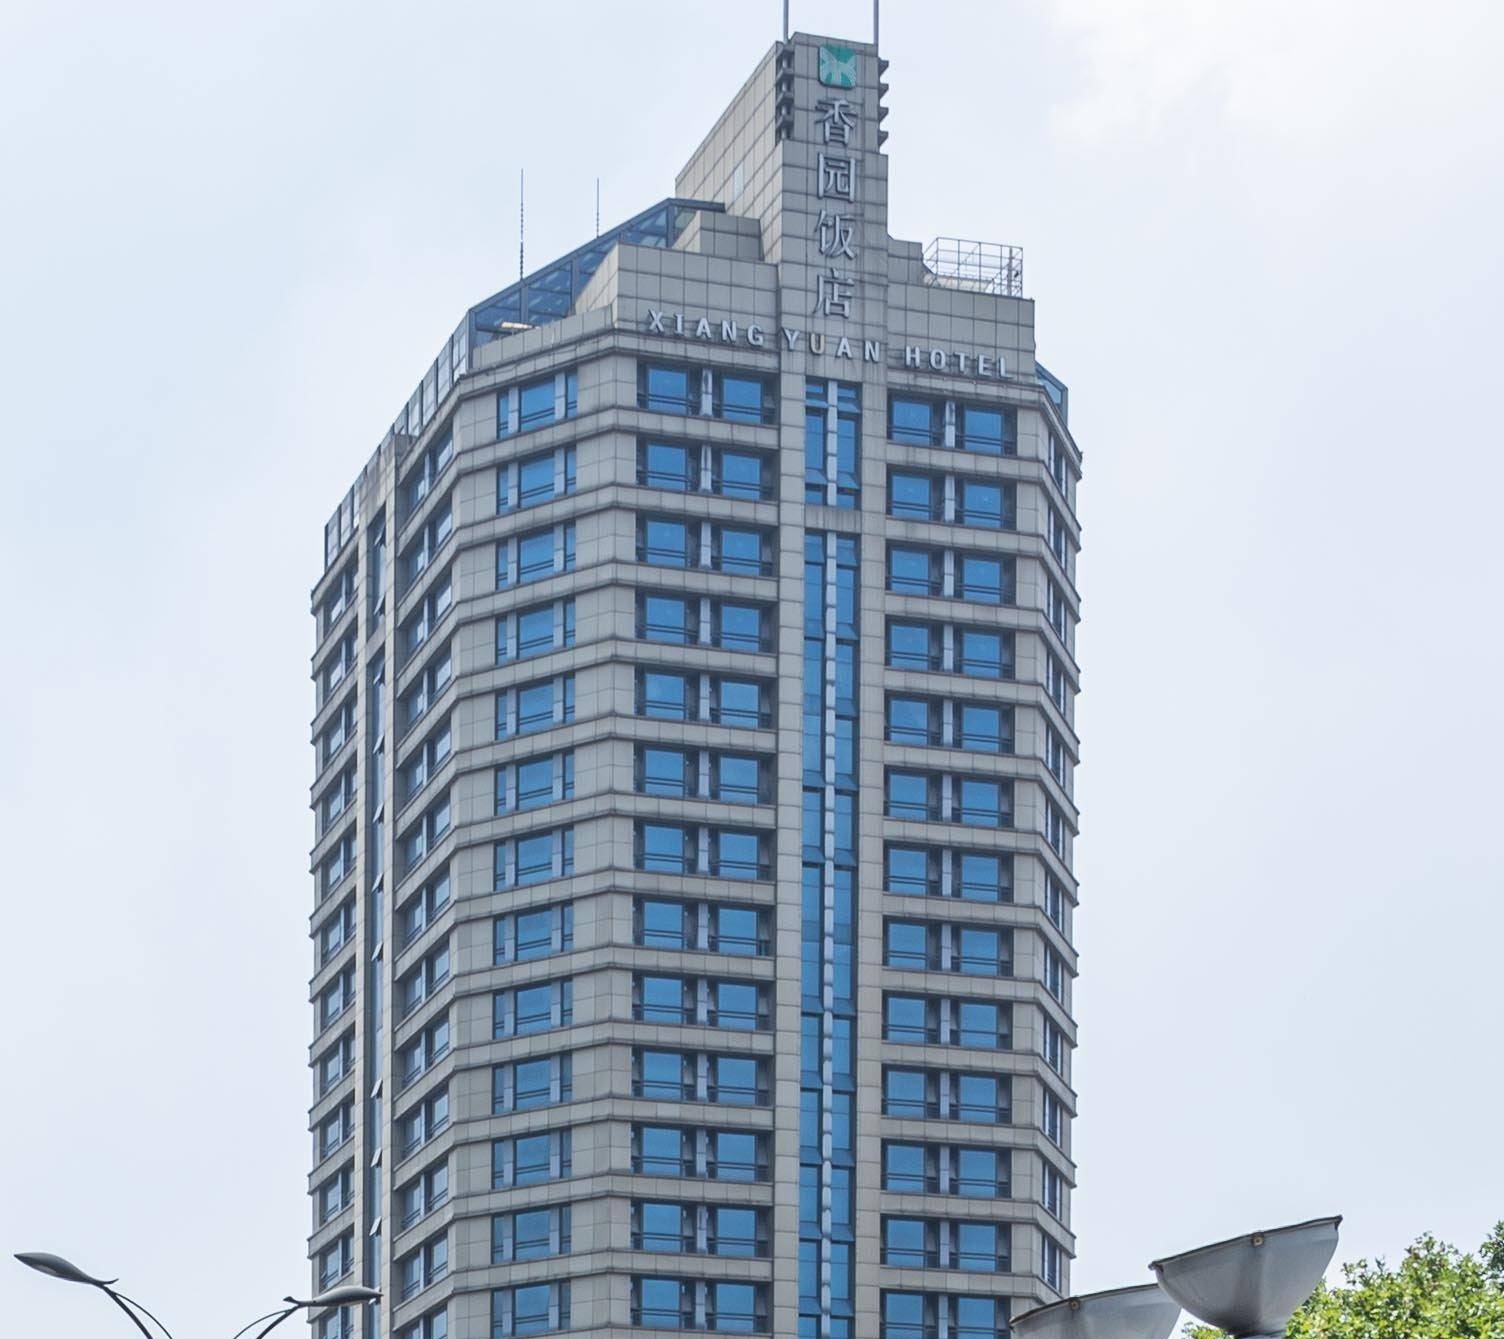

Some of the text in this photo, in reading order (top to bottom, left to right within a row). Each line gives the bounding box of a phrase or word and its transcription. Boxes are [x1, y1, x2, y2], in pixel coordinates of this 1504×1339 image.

[813, 99, 858, 320] 香园饭店
[647, 307, 1015, 380] XIANG YUAN HOTEL
